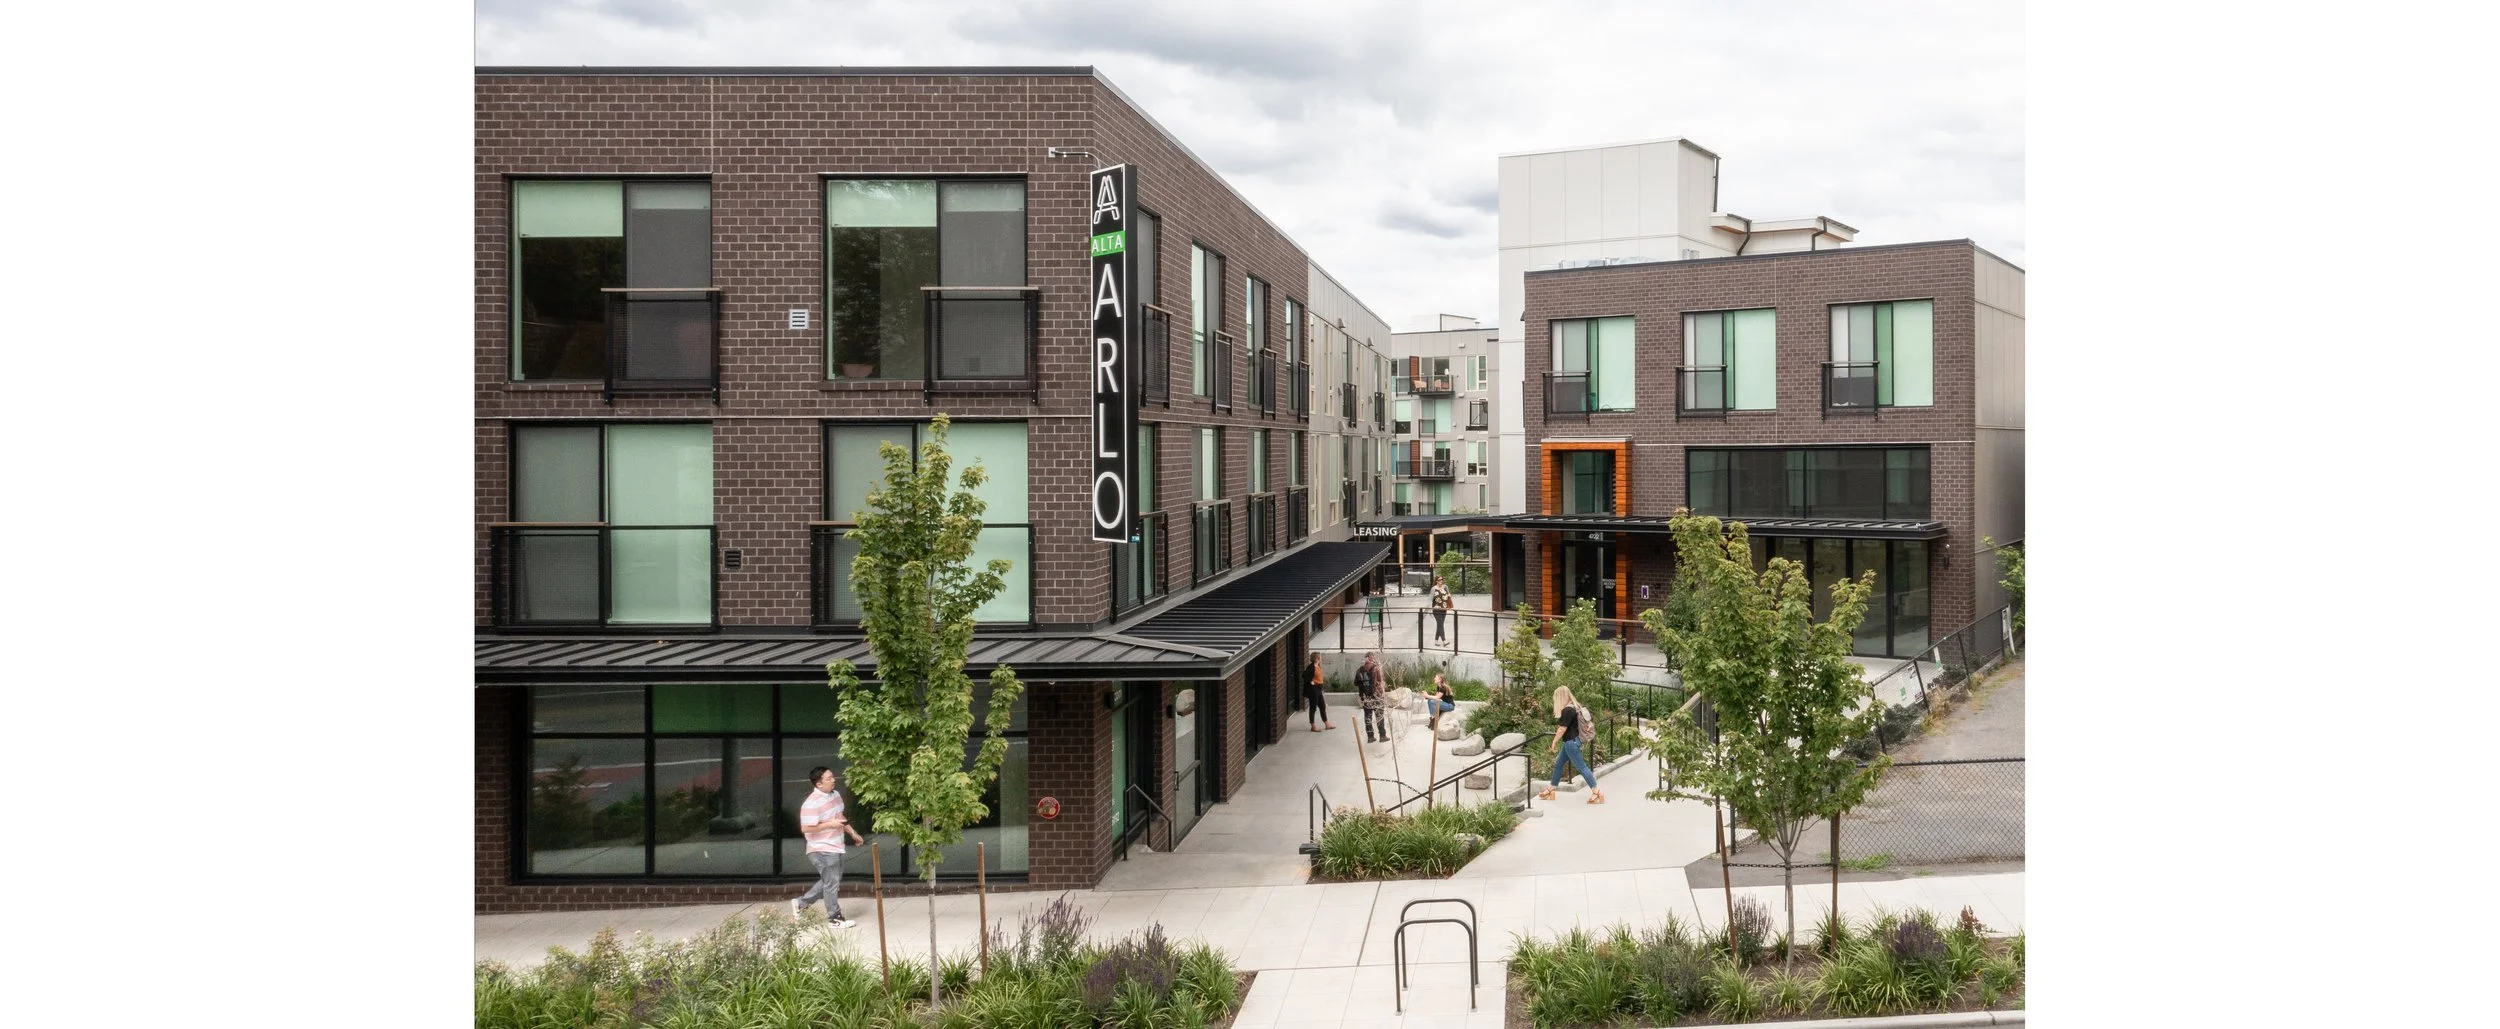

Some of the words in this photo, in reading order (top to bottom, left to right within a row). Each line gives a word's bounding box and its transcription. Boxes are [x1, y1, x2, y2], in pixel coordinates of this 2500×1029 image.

[1092, 234, 1123, 254] ALTA
[1093, 263, 1125, 529] ARLO
[1353, 527, 1397, 536] LEASING
